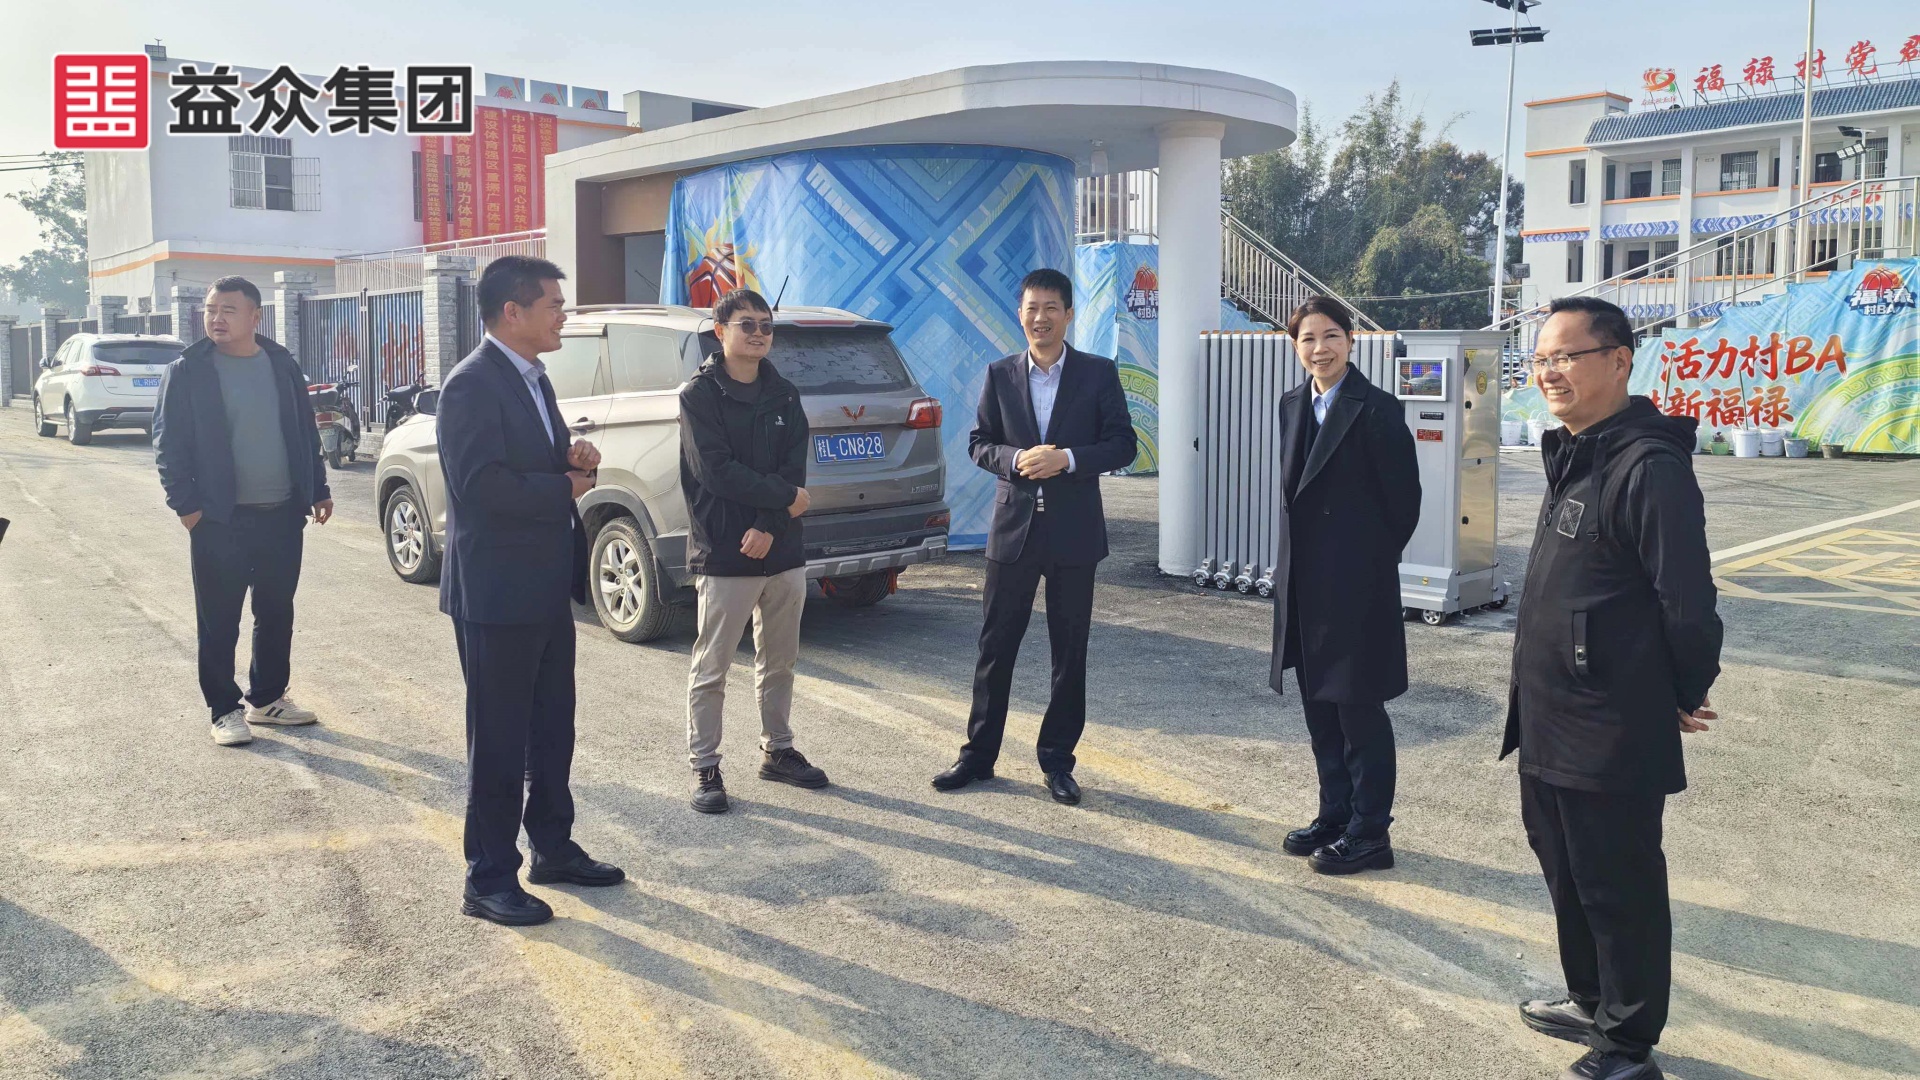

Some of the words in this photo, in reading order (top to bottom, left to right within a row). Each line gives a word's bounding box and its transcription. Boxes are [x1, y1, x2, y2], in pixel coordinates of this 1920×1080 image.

[1137, 307, 1158, 319] 村BA
[1864, 303, 1895, 315] 村BA
[1660, 332, 1848, 383] 活力村BA
[1645, 385, 1794, 428] 新福禄
